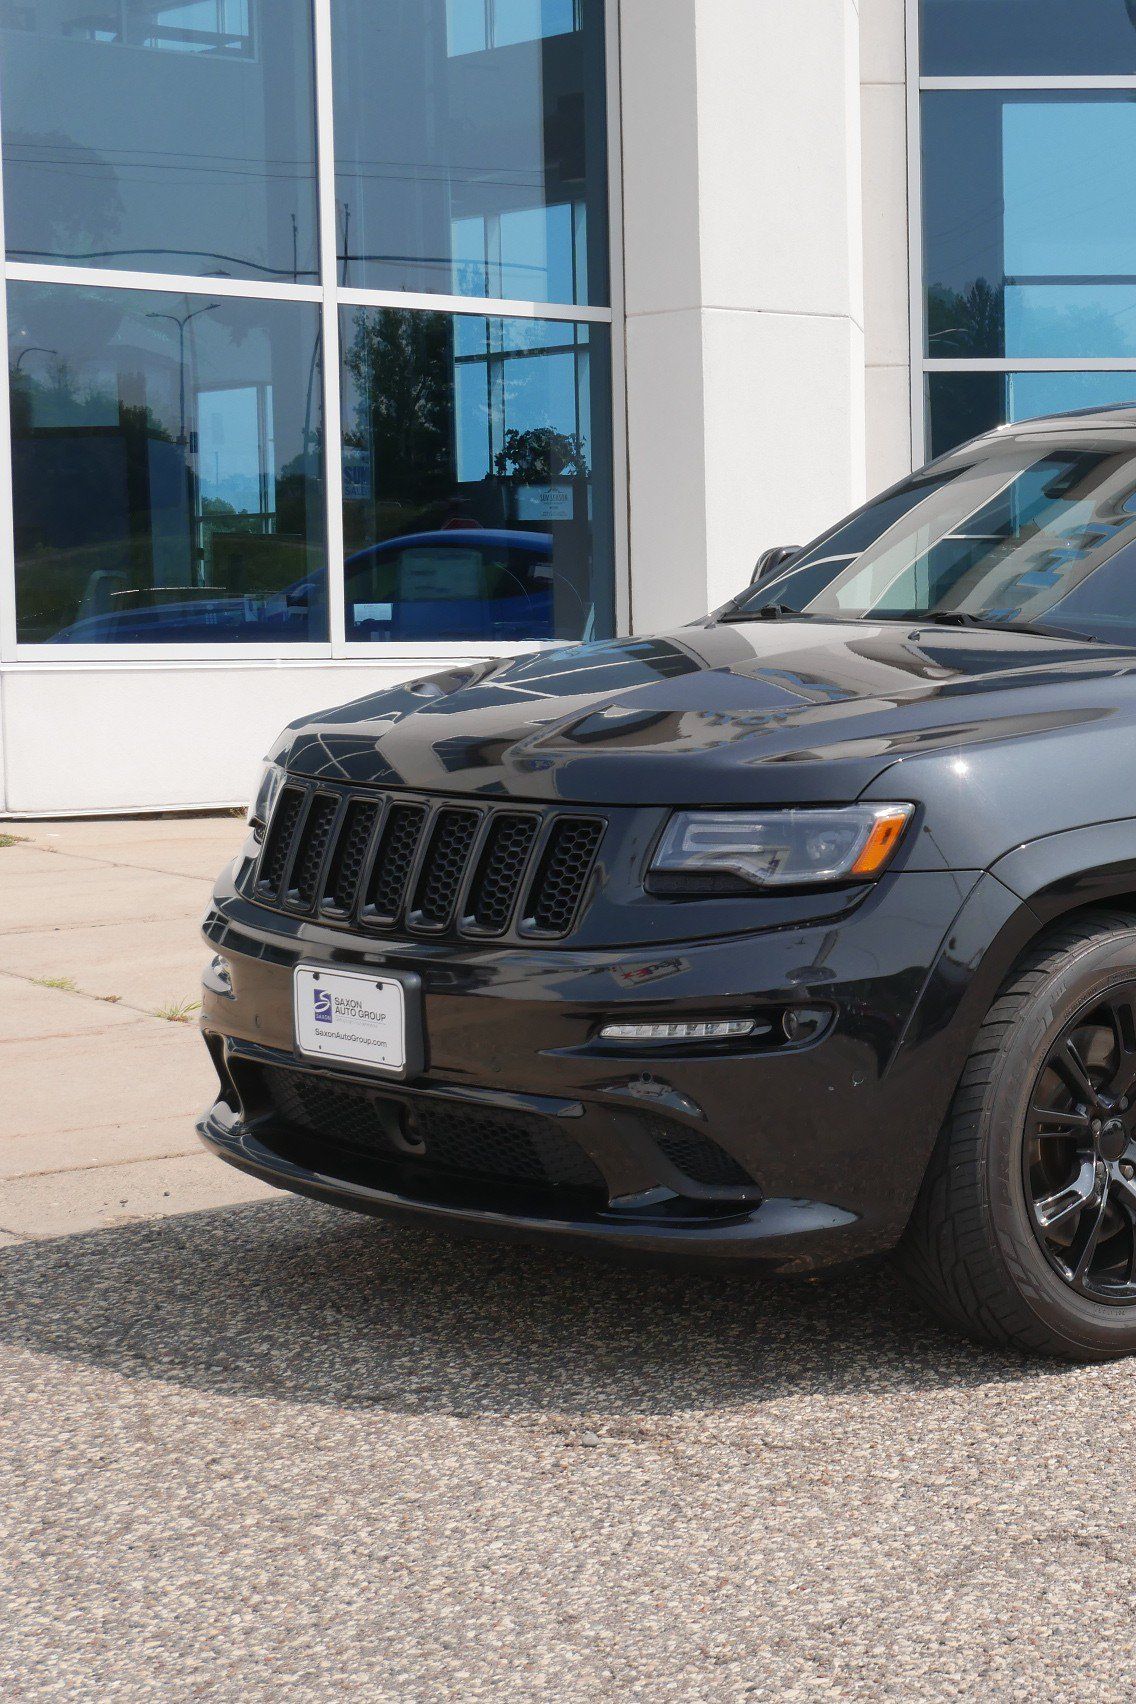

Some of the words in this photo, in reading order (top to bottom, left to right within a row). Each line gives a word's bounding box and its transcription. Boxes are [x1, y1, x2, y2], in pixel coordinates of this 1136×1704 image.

[335, 997, 362, 1009] SAXON
[335, 1006, 357, 1017] AUTO
[358, 1009, 386, 1022] GROUP
[315, 1028, 387, 1047] SaxonAutoGroup.com
